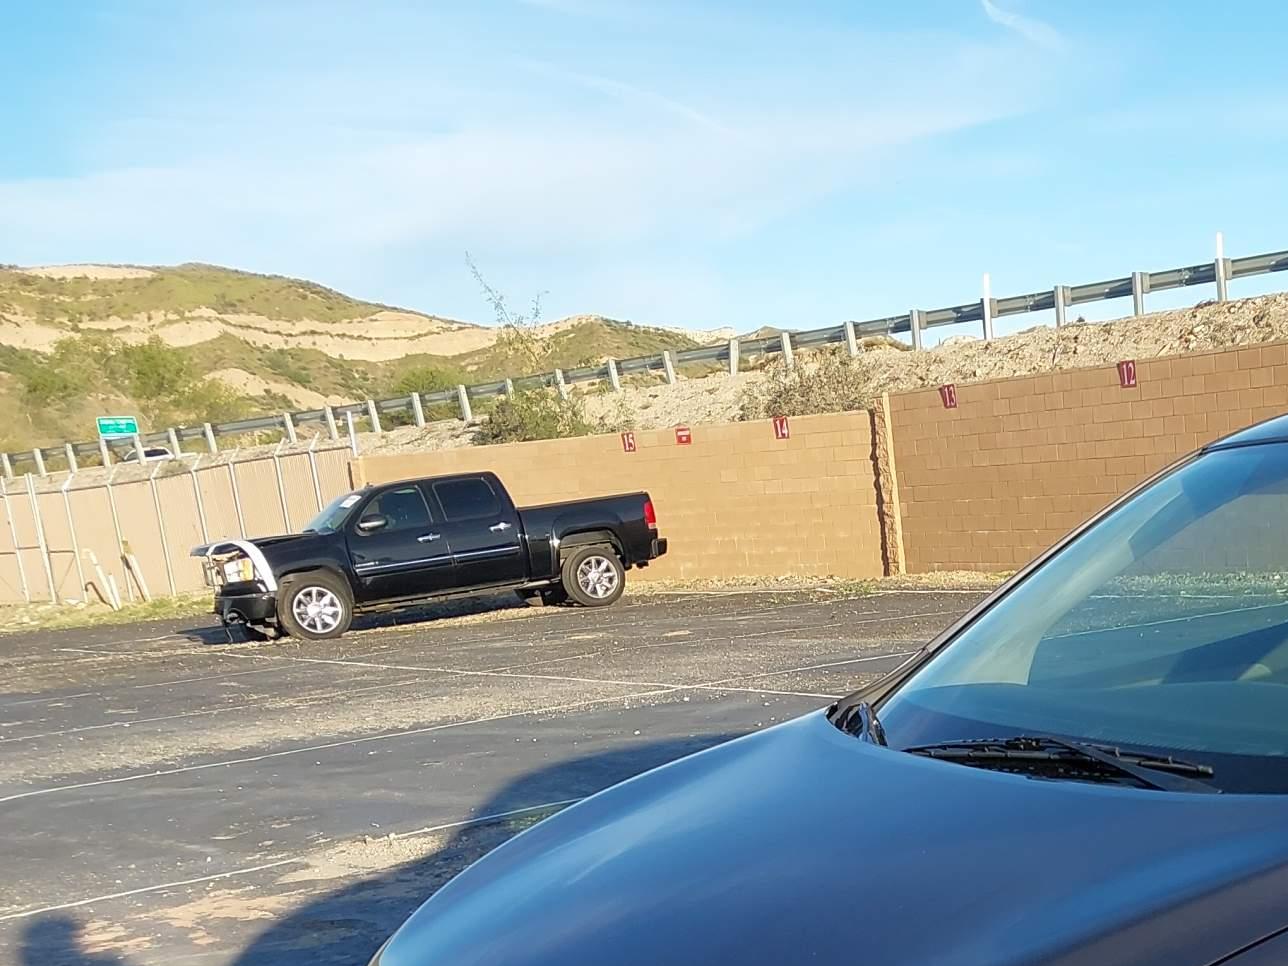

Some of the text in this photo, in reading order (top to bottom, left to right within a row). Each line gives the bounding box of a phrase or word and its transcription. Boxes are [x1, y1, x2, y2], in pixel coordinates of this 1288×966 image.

[1122, 361, 1136, 385] 12
[944, 385, 956, 407] 13
[775, 418, 789, 438] 14
[623, 433, 636, 451] 15
